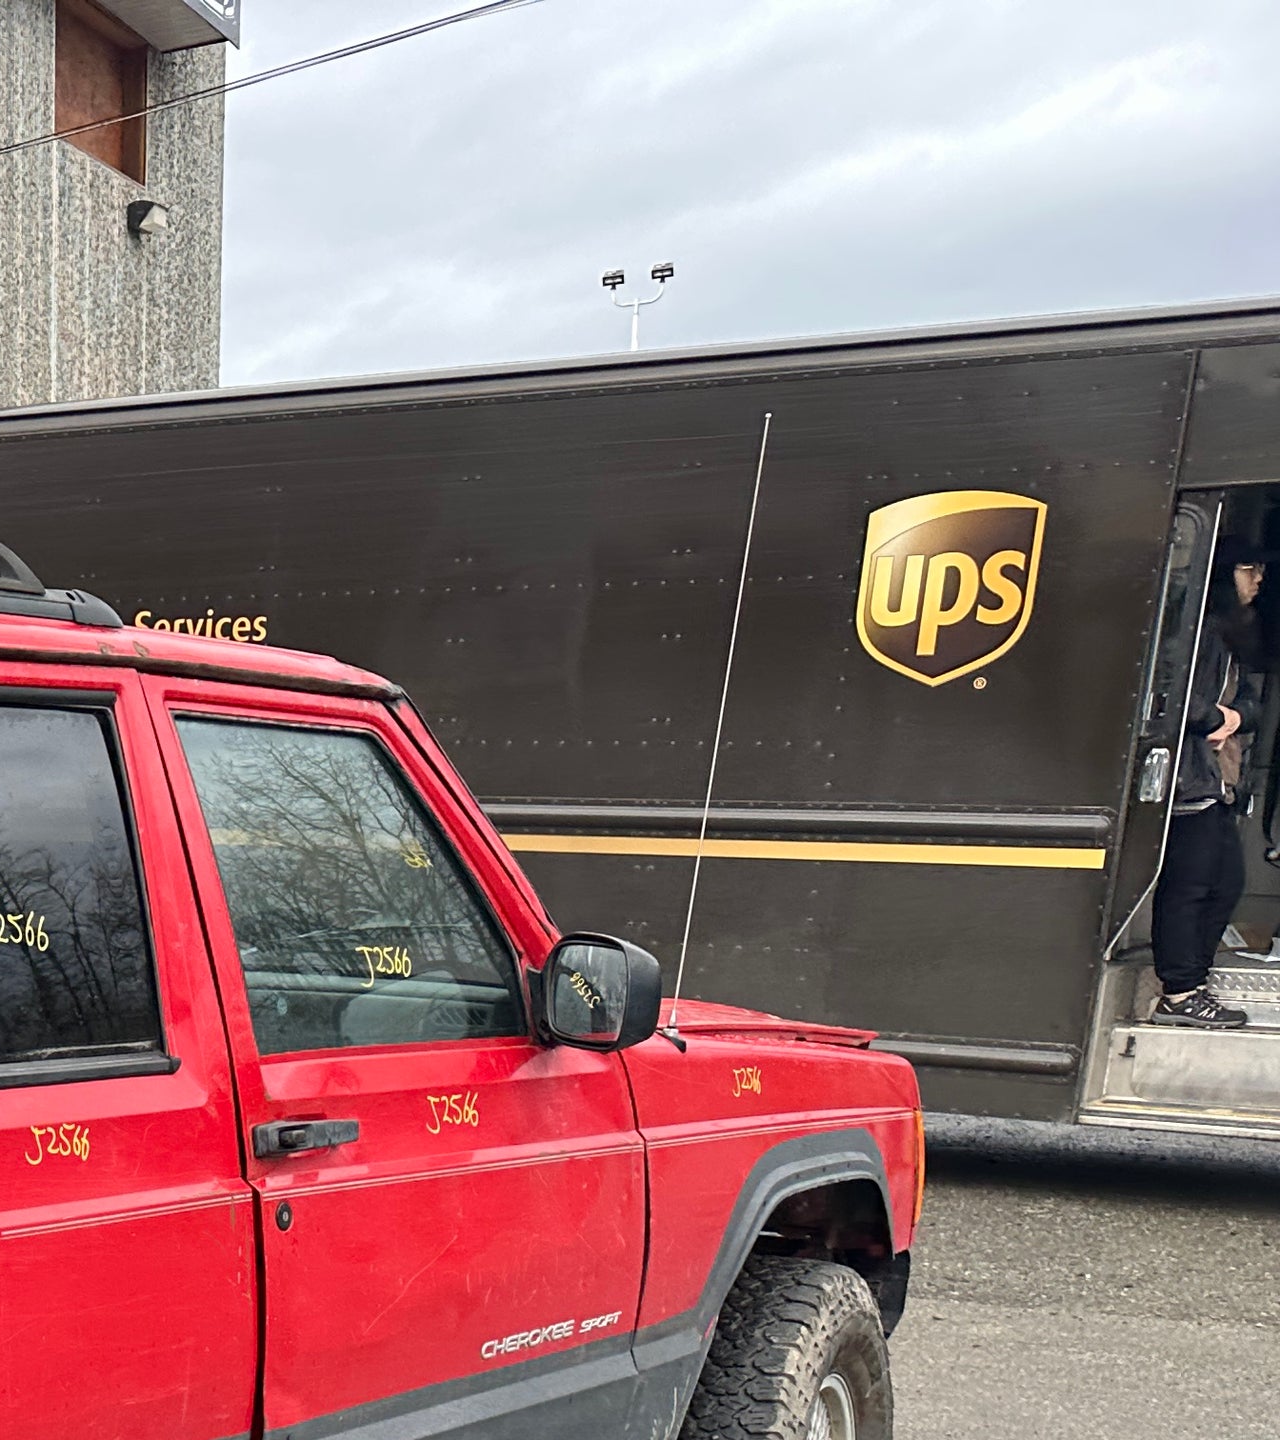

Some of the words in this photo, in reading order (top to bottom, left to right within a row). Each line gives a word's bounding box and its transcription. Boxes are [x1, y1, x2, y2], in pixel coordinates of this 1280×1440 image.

[869, 549, 1027, 657] ups
[134, 608, 268, 643] Services
[354, 945, 413, 988] J2566
[732, 1064, 763, 1098] J2566
[426, 1090, 481, 1135] J2566
[24, 1122, 91, 1166] J2566
[480, 1318, 577, 1360] CHEROKEE
[578, 1310, 623, 1334] SPORT
